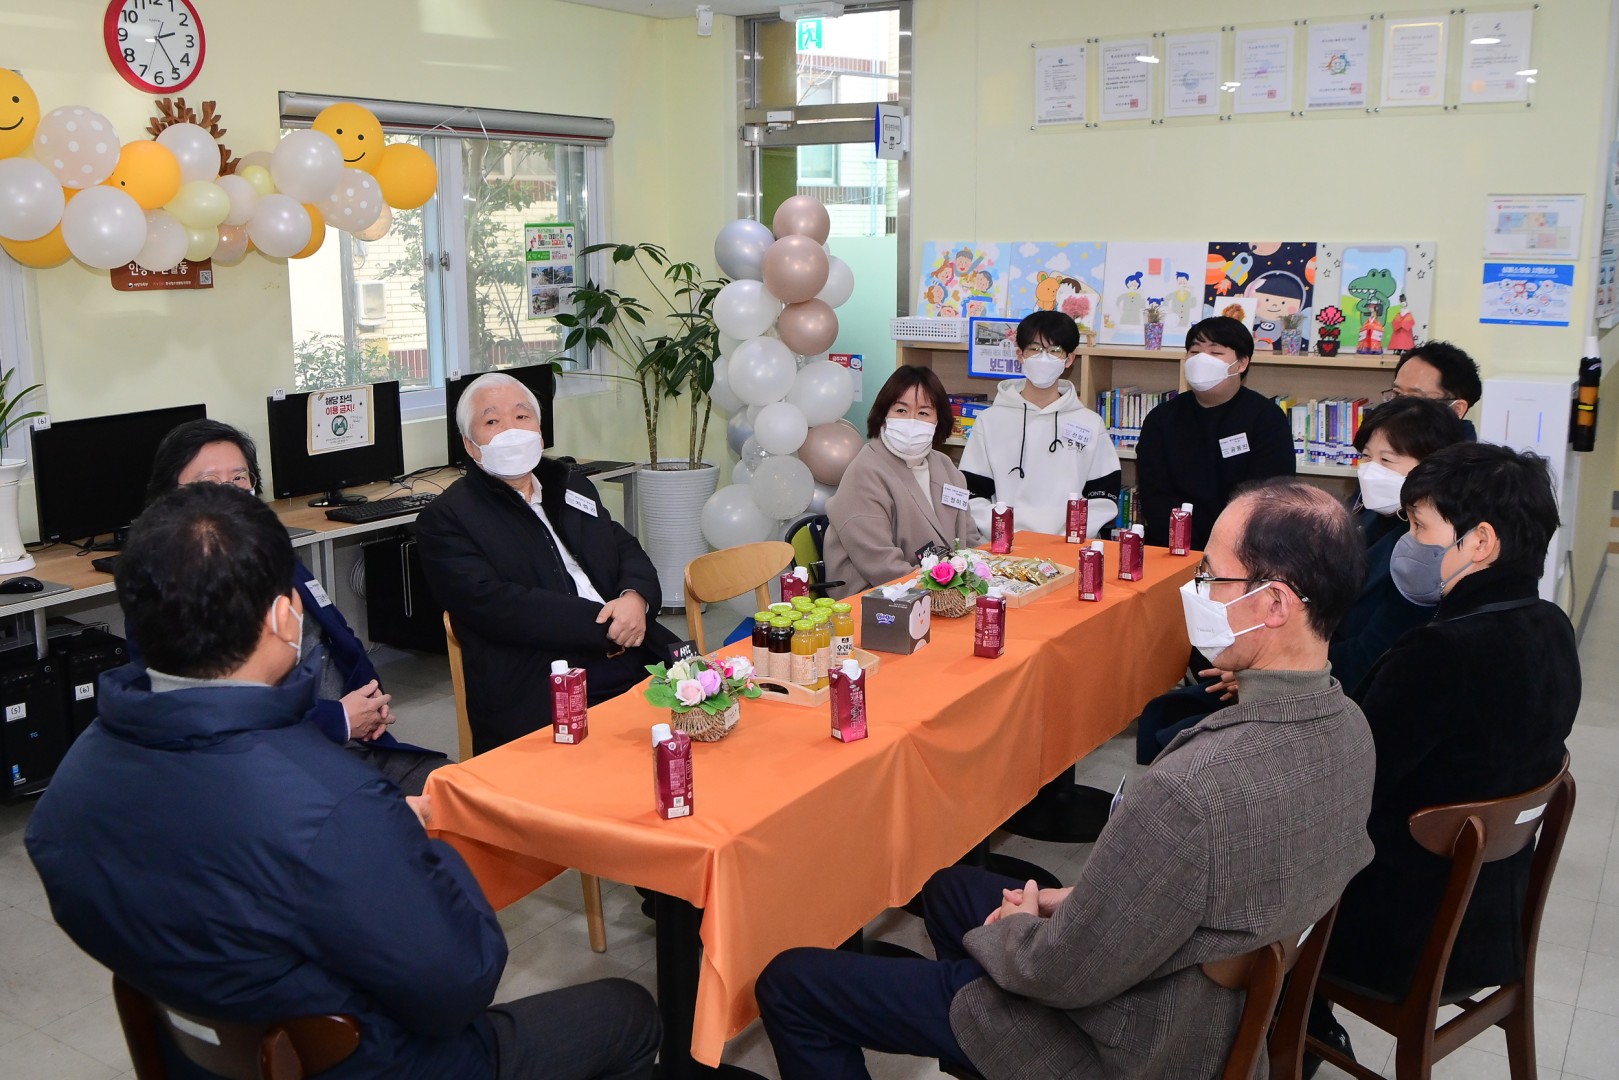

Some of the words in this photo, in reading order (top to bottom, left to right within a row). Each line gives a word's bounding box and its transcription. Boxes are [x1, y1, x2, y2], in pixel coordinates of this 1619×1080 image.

[121, 10, 139, 23] 10
[179, 13, 189, 27] 2
[117, 28, 128, 41] 9
[185, 34, 195, 48] 3
[124, 47, 135, 63] 8
[180, 53, 191, 67] 4
[139, 64, 148, 77] 7
[171, 67, 181, 80] 5
[154, 71, 165, 85] 6
[325, 396, 339, 406] 해당
[339, 394, 353, 403] 좌석
[325, 406, 339, 415] 이용
[339, 404, 355, 414] 금지!
